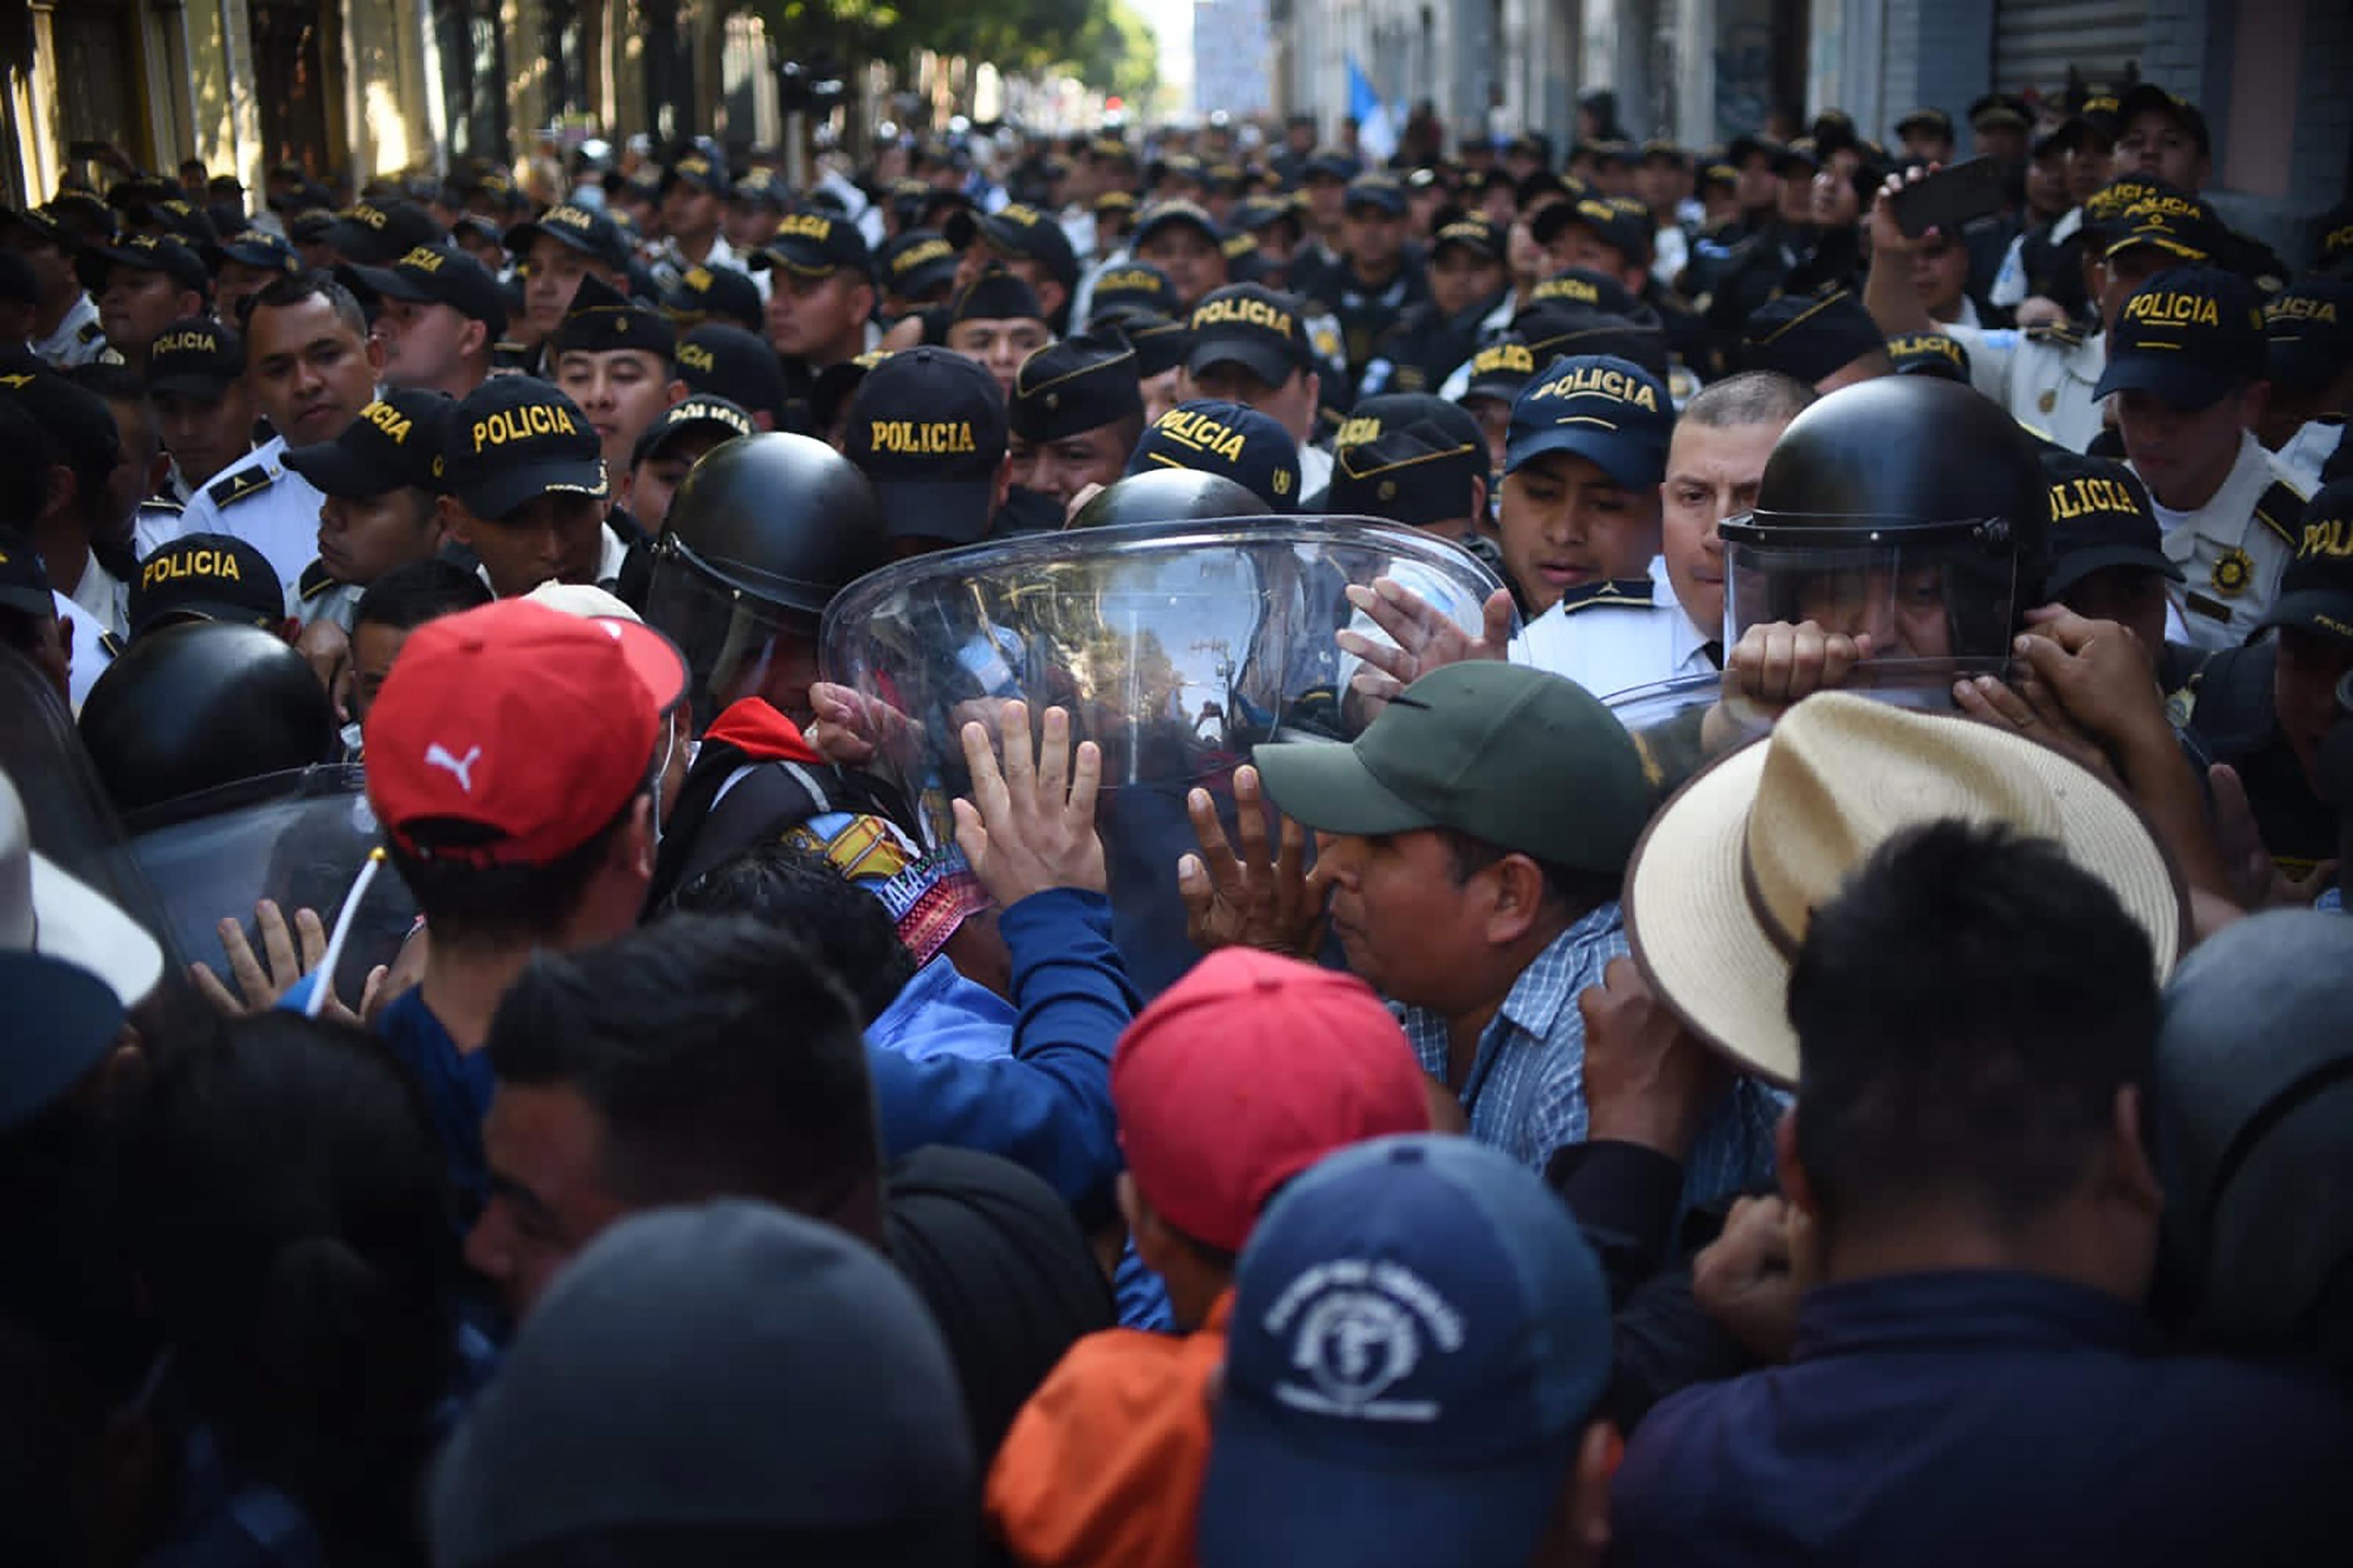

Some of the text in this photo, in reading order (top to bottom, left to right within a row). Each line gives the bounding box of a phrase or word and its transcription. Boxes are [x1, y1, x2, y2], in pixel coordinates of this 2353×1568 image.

[1191, 298, 1293, 340] POLICIA
[2124, 293, 2219, 326] POLICIA
[1530, 366, 1658, 413] POLICIA
[473, 406, 576, 453] POLICIA
[871, 421, 976, 453] POLICIA
[1151, 409, 1247, 463] POLICIA
[142, 551, 241, 590] POLICIA
